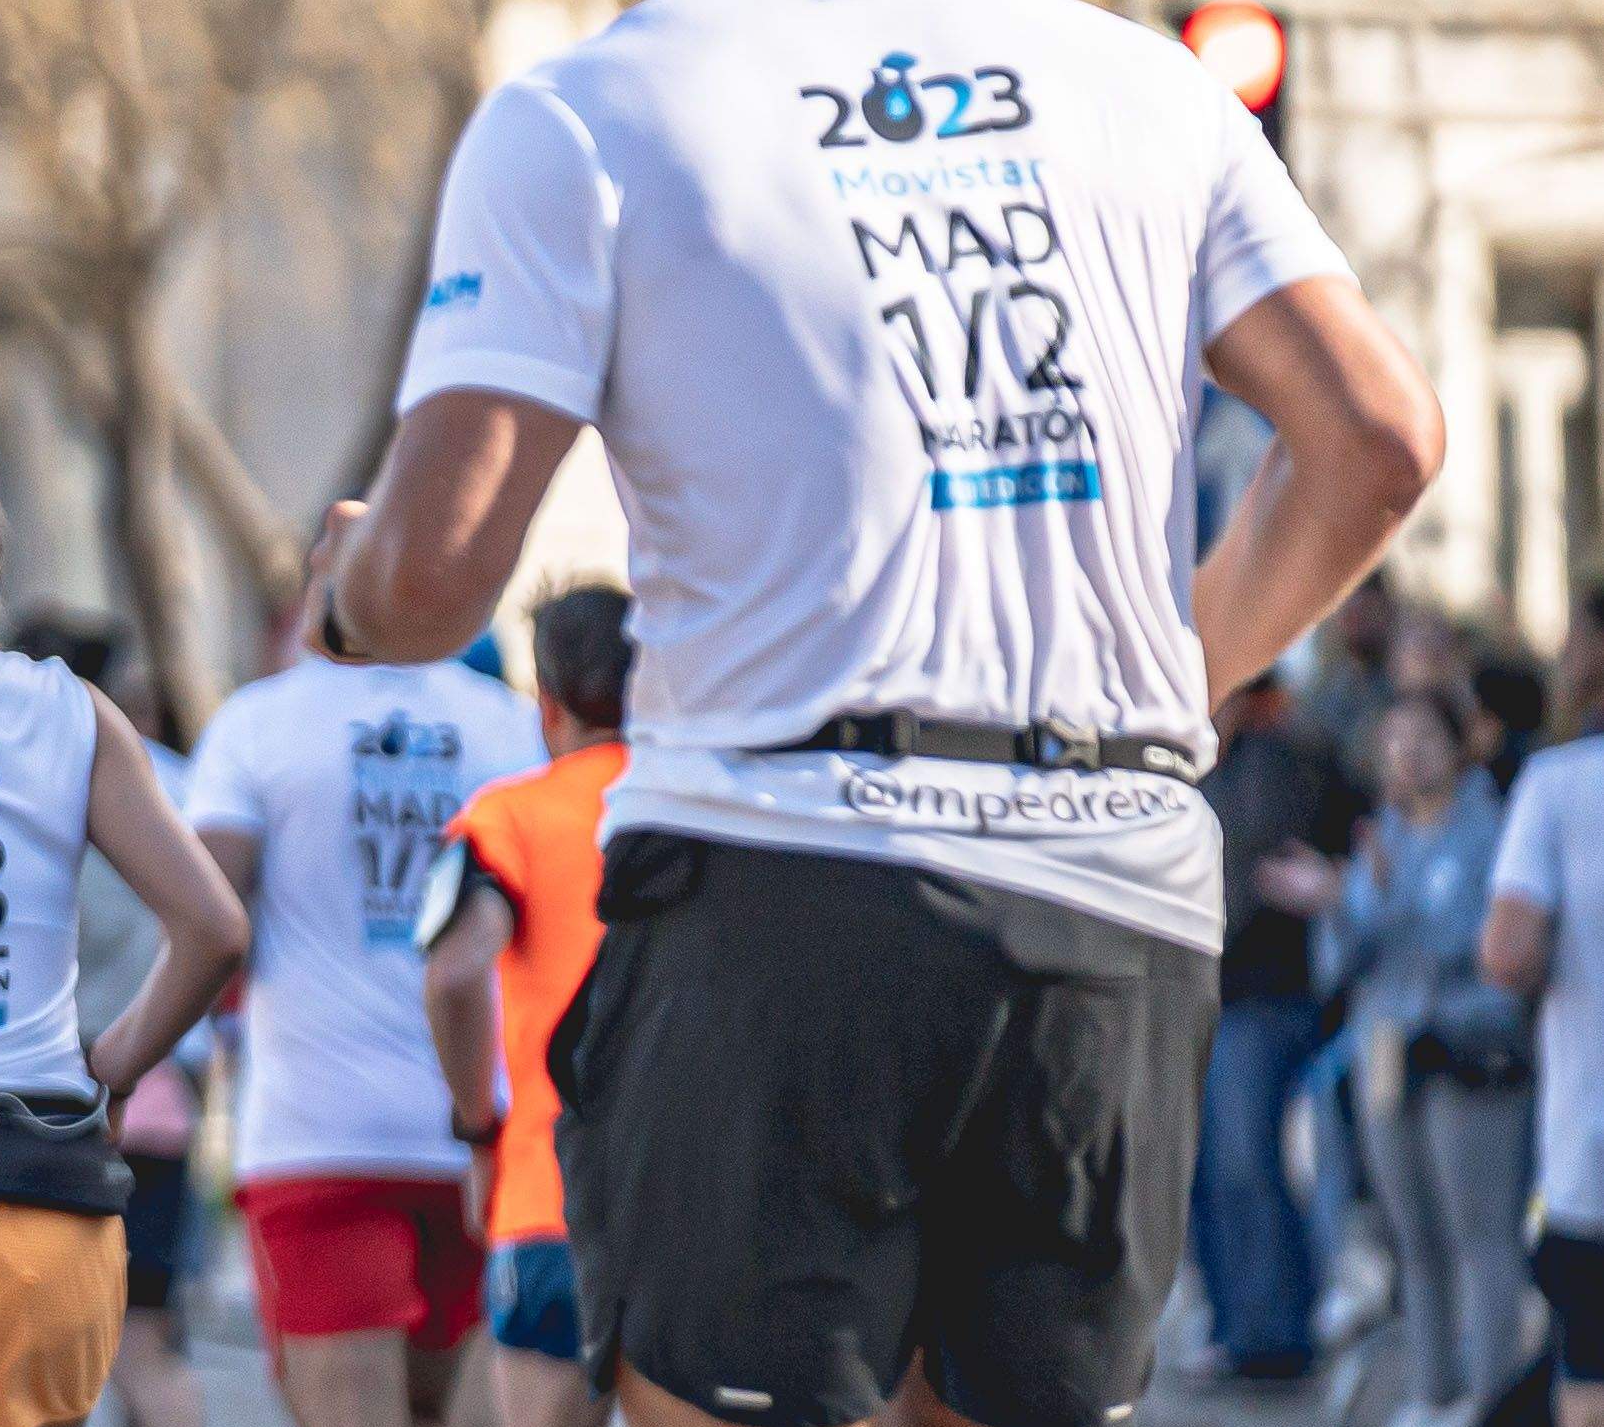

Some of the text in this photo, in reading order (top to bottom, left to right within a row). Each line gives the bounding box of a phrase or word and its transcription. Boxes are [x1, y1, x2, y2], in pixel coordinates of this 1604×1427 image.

[801, 54, 1032, 148] 2023
[832, 154, 1044, 201] Movistar
[848, 205, 1060, 279] MAD
[881, 281, 1085, 402] 1/2
[355, 830, 450, 888] 1/
